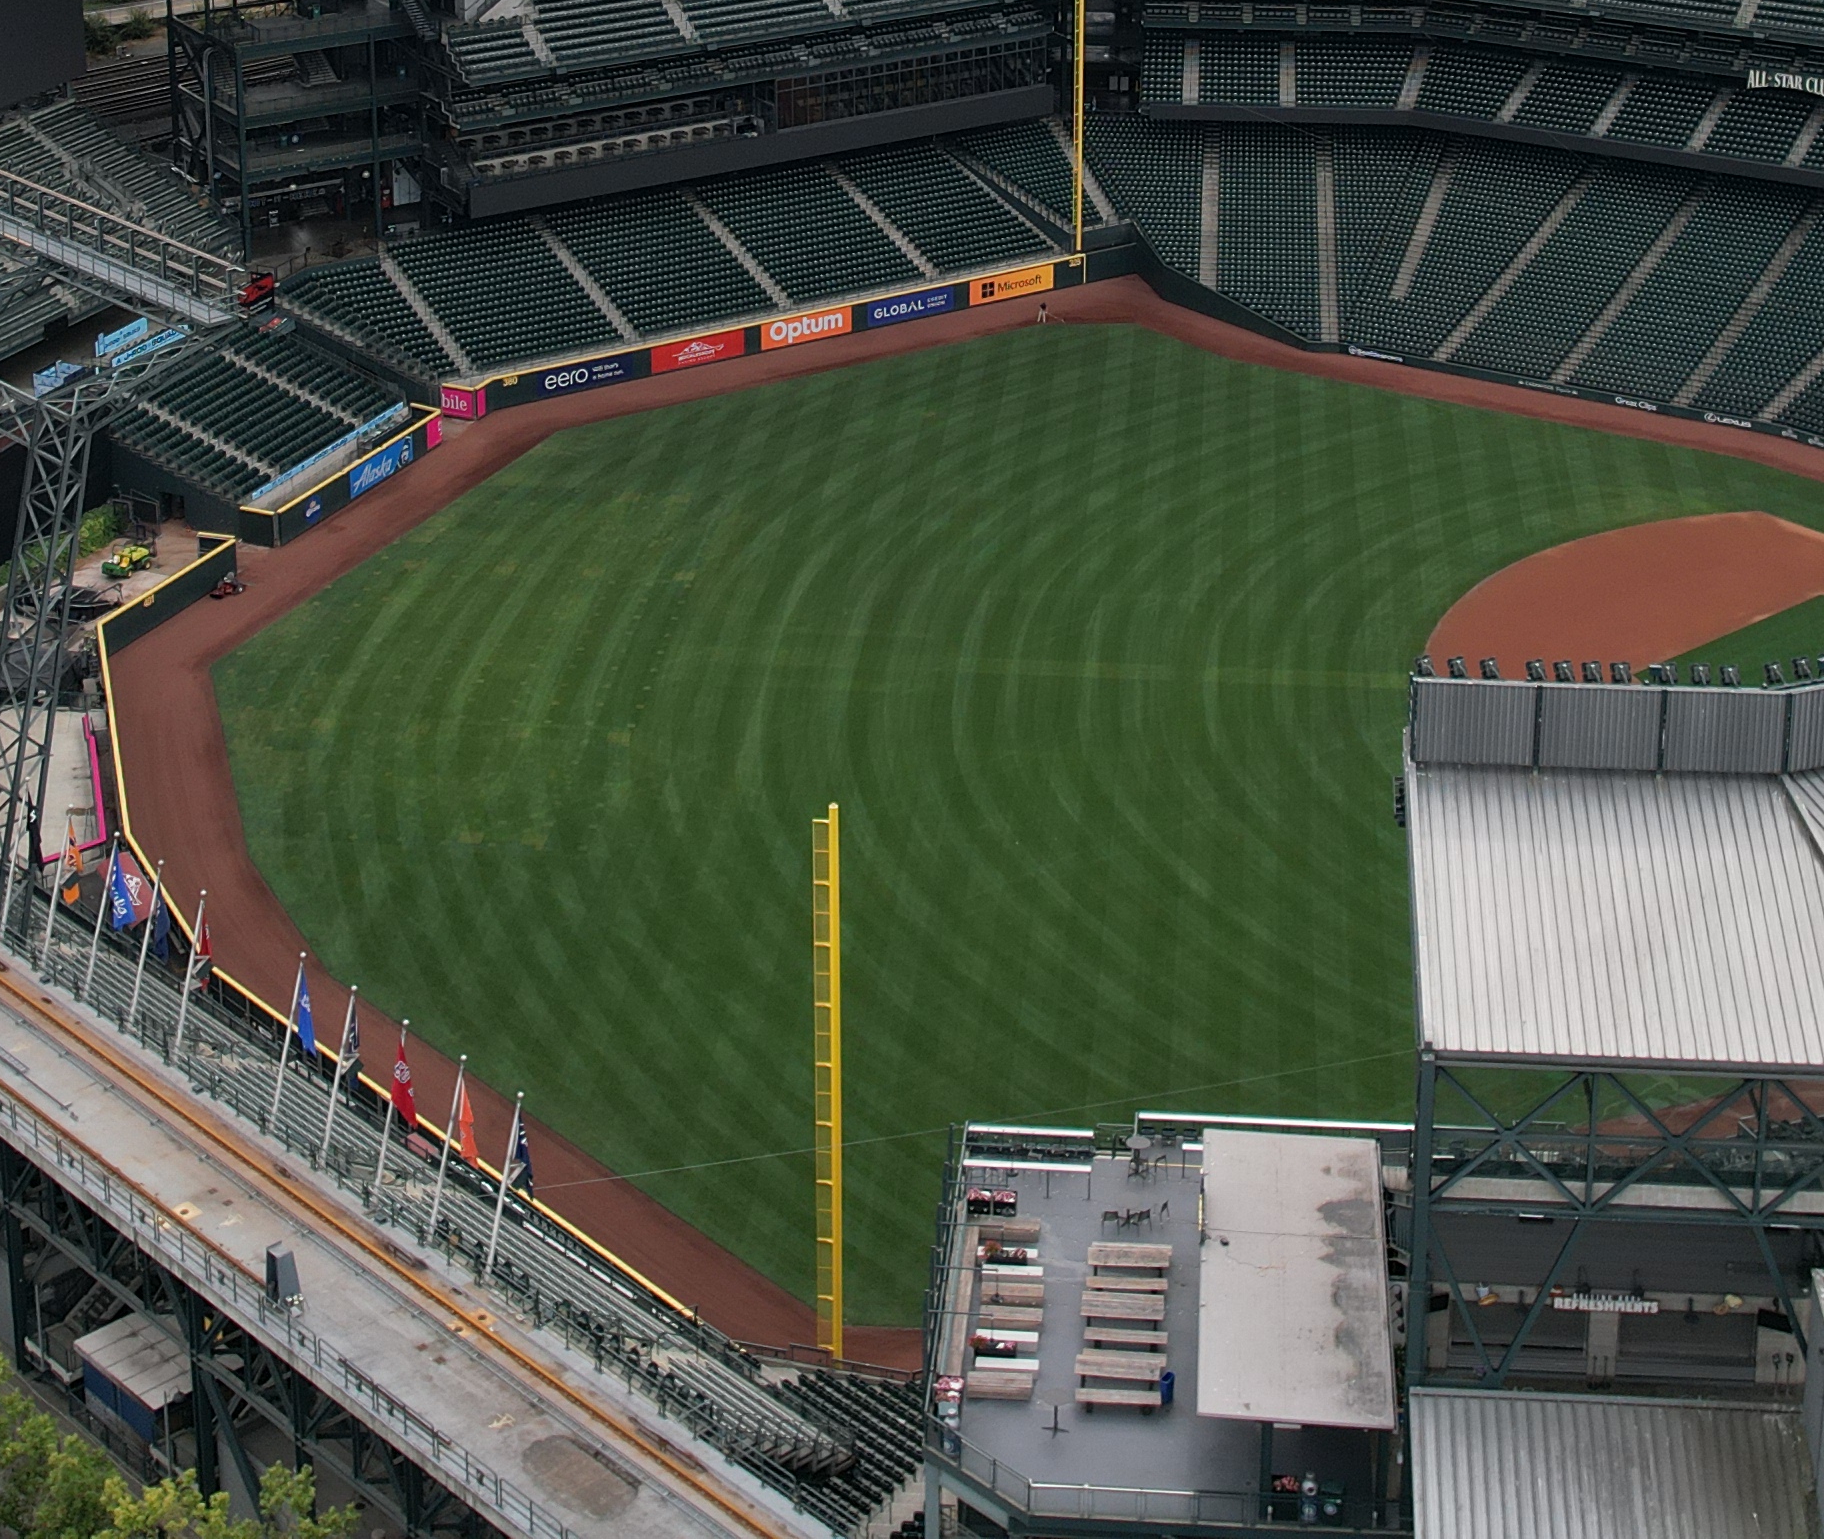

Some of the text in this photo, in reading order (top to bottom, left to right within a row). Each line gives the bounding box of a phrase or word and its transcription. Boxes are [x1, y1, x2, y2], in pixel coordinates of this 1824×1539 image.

[997, 274, 1042, 293] Microsoft
[874, 300, 925, 319] GLOBAL
[770, 312, 842, 343] Optum
[544, 368, 588, 390] eero
[1716, 417, 1752, 428] LEXUS
[352, 455, 394, 494] Alaska
[1553, 1297, 1658, 1314] REFRESHMENTS
